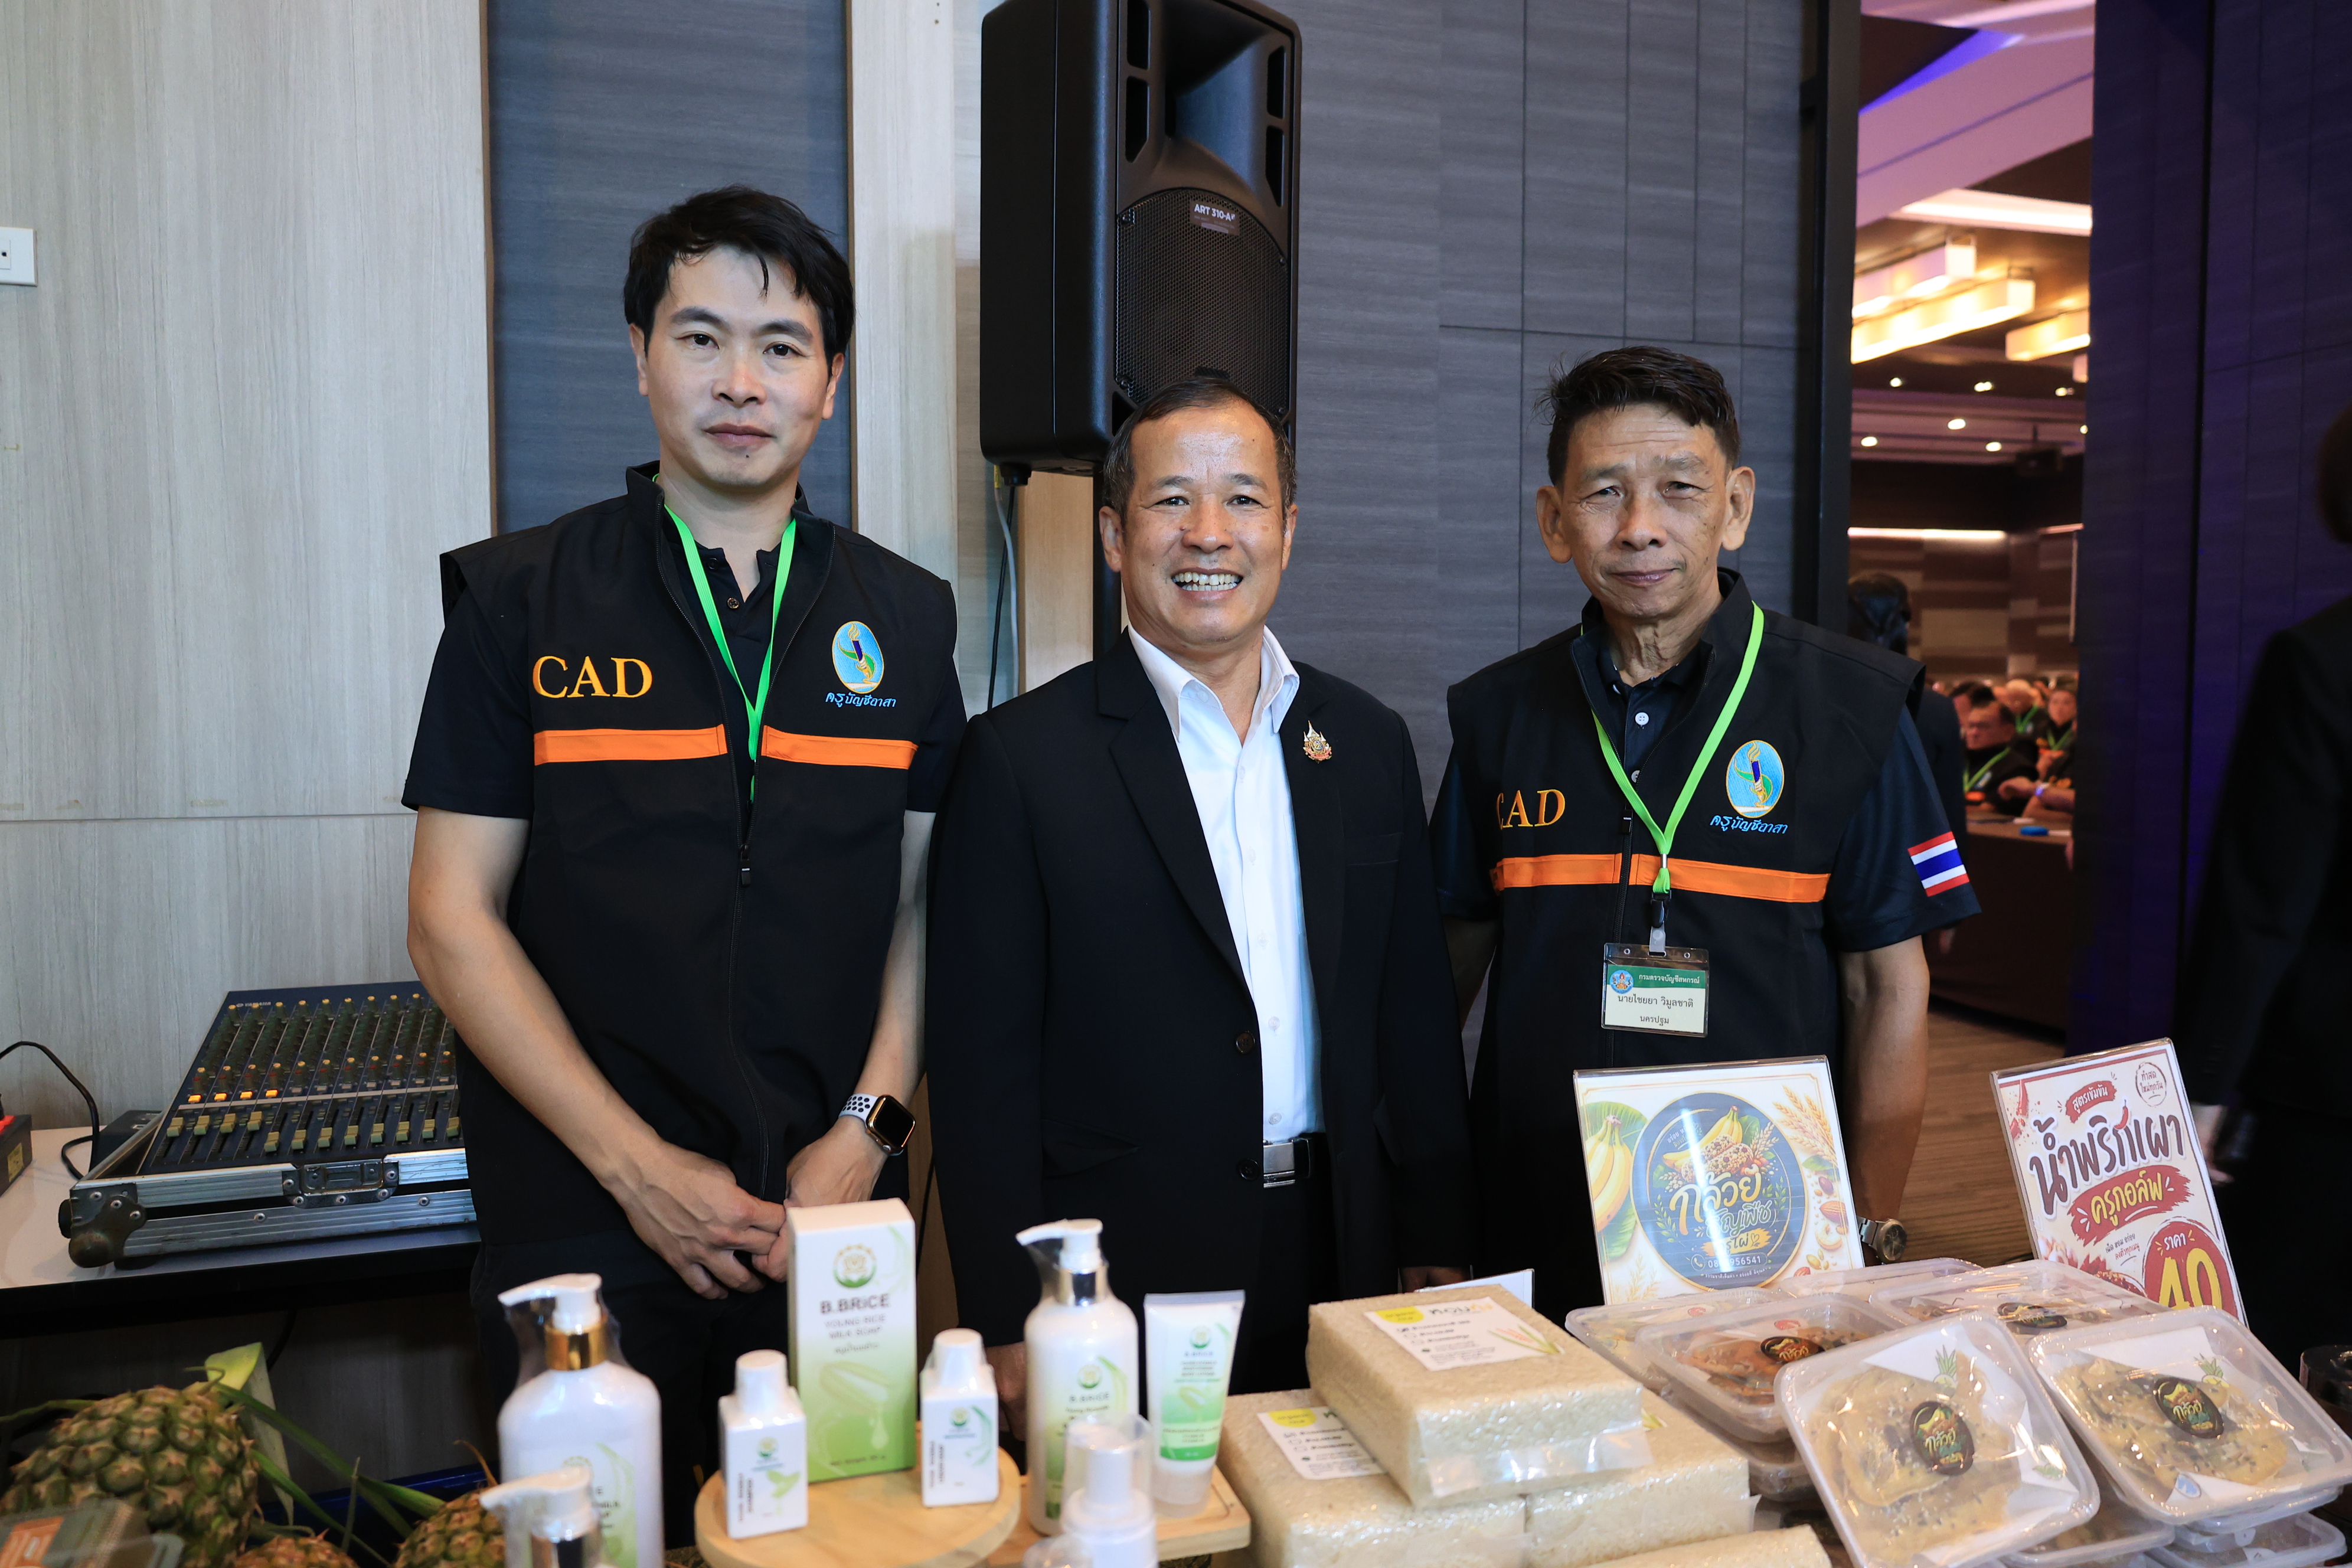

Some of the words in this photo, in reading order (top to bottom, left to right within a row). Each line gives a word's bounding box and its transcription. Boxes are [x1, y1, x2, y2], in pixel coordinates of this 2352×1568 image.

[1194, 204, 1210, 215] ART
[533, 655, 652, 698] CAD
[825, 692, 896, 708] ครูบัญชีอาสา
[1710, 815, 1788, 834] ครูบัญชีอาสา
[1639, 974, 1700, 984] กรมตรวจบัญชีสหกรณ์
[1618, 994, 1658, 1005] นายไชยยา
[1661, 996, 1693, 1009] วิมูลชาติ
[1640, 1015, 1670, 1026] นครปฐม
[2141, 1070, 2157, 1082] ทำสด
[2072, 1084, 2108, 1113] สูตรเข้มข้น
[2030, 1115, 2183, 1215] น้ำพริกเผา
[1669, 1171, 1762, 1236] กล้วย
[2164, 1233, 2186, 1250] ราคา
[1708, 1255, 1761, 1268] 08956541
[2159, 1247, 2222, 1310] 40
